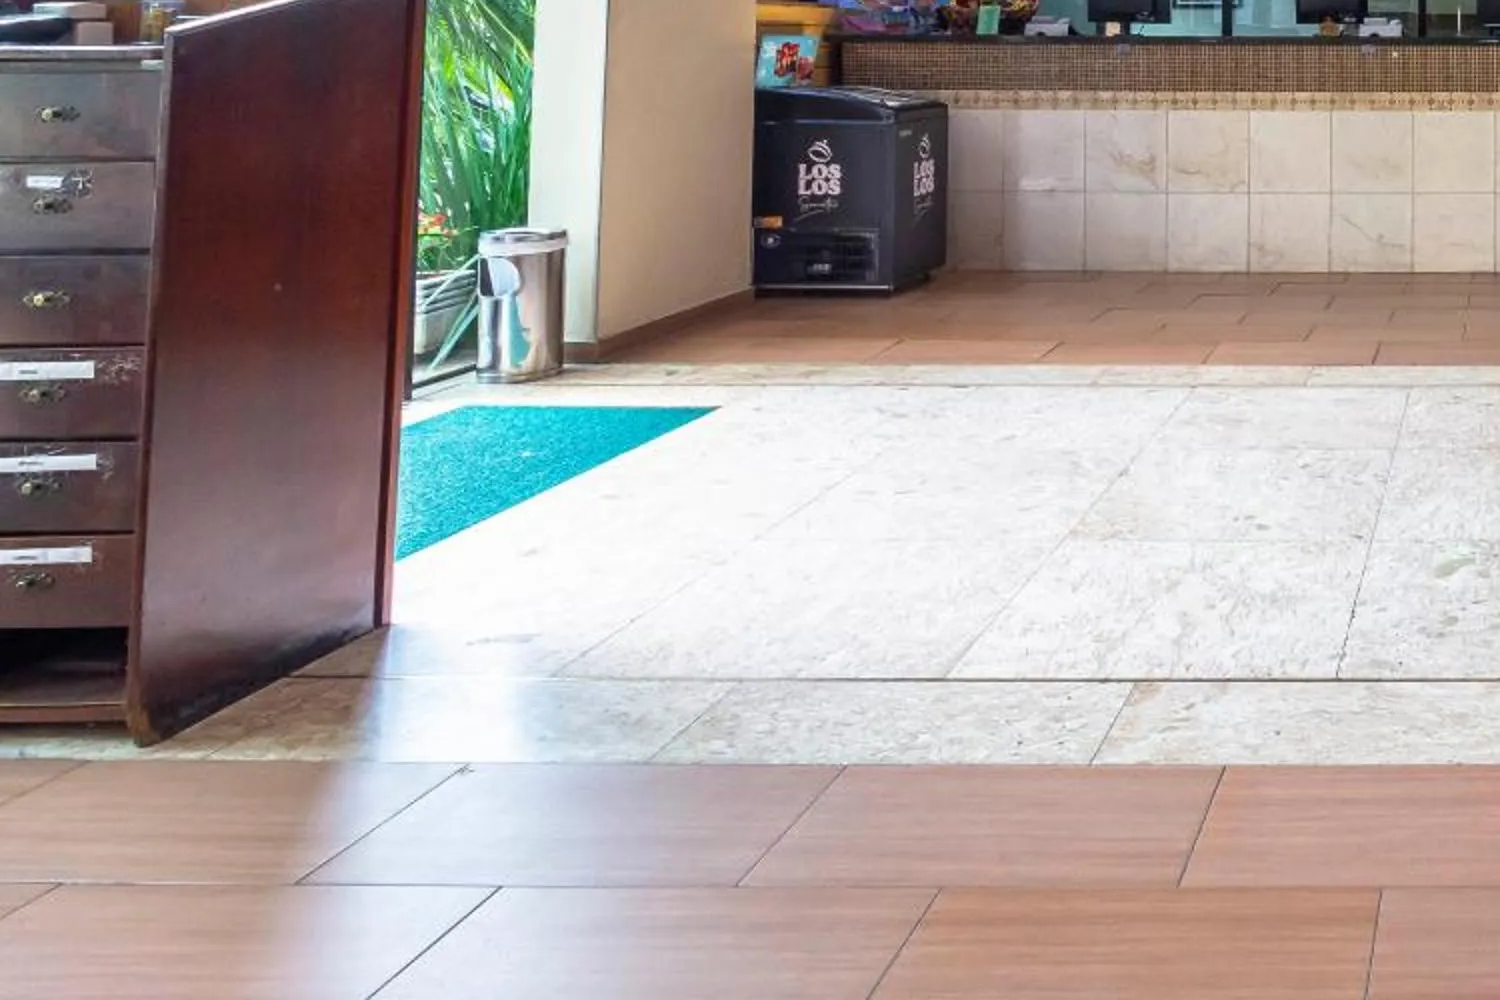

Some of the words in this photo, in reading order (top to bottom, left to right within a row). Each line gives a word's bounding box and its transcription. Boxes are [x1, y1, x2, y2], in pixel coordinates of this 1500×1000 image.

[798, 163, 841, 179] LOS
[913, 159, 935, 179] LOS
[798, 179, 841, 195] LOS
